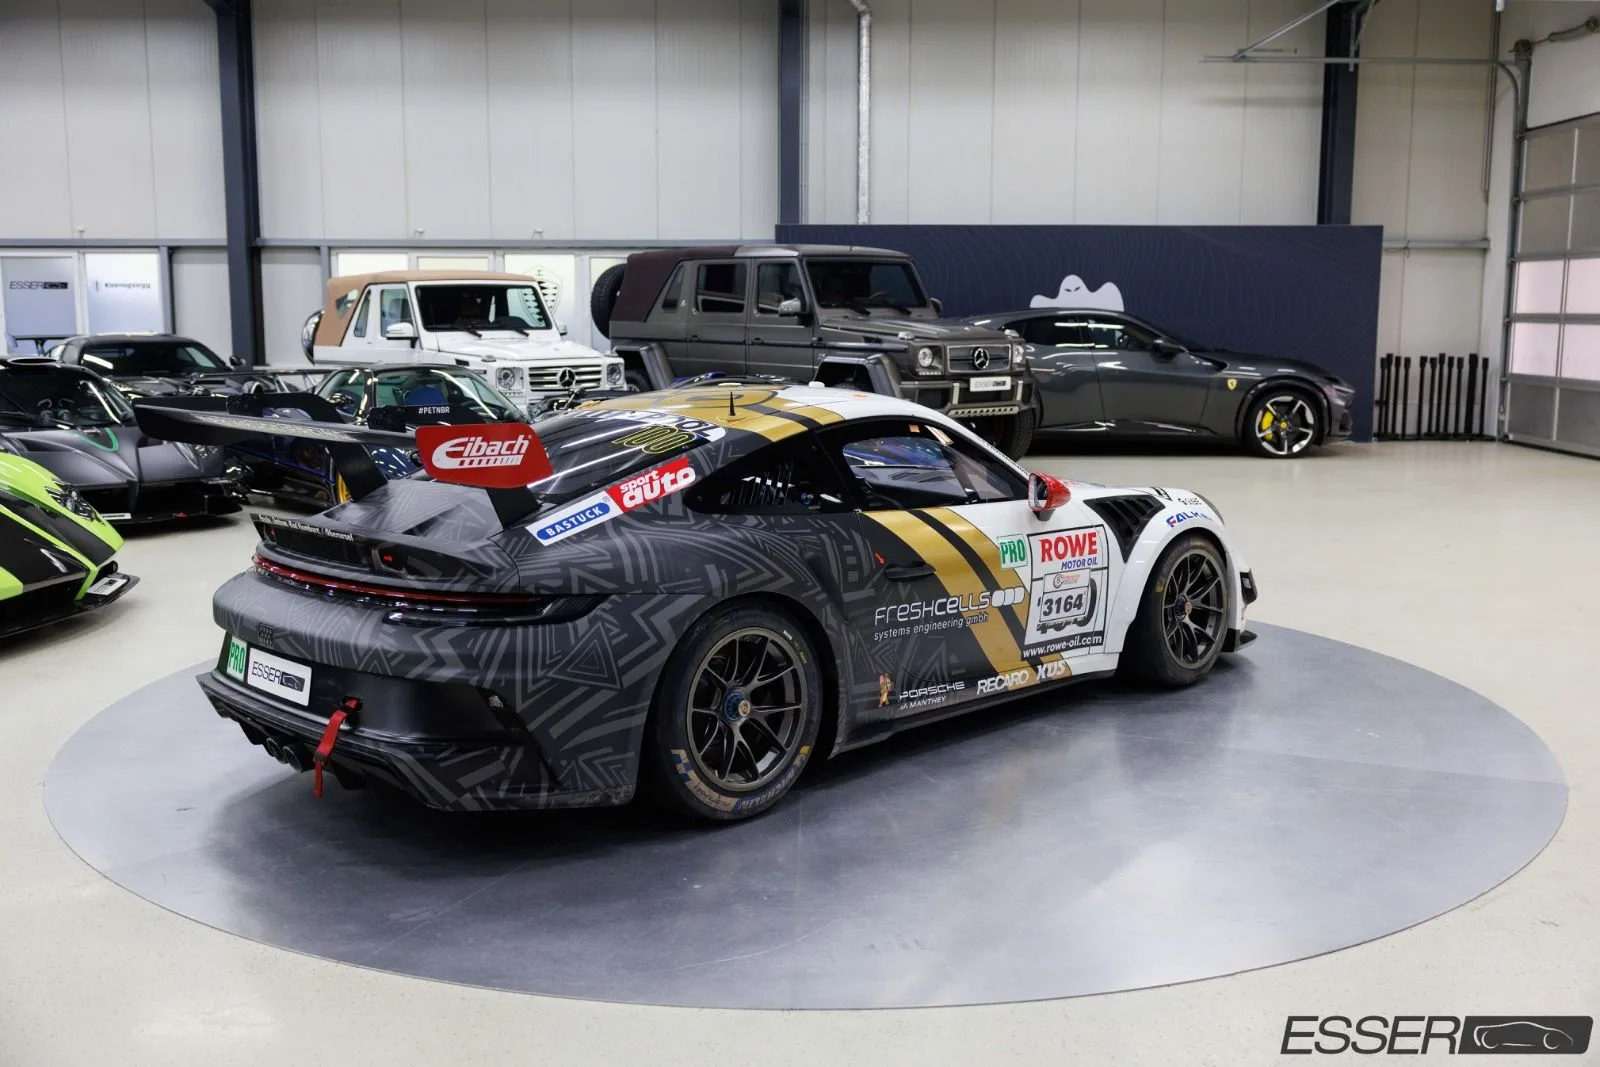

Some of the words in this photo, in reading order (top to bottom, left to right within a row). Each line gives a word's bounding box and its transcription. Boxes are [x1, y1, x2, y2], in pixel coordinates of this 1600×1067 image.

[10, 281, 43, 289] ESSER
[432, 435, 530, 470] Eibach
[620, 469, 660, 493] sport
[622, 466, 696, 509] auto
[545, 506, 604, 537] BASTUCK
[1000, 539, 1026, 565] PRO
[1040, 532, 1098, 563] ROWE
[1061, 558, 1086, 570] MOTOR
[1087, 557, 1099, 567] OIL
[1043, 594, 1083, 616] 3164
[874, 626, 911, 641] systems
[913, 617, 963, 634] engineering
[965, 612, 989, 626] gmbh
[229, 641, 246, 674] PRO
[1023, 635, 1102, 658] www.rowe-oil.com
[252, 661, 281, 684] ESSER
[977, 669, 1030, 695] RECARO
[900, 681, 966, 701] PORSCHE
[909, 696, 947, 709] MANTHEY
